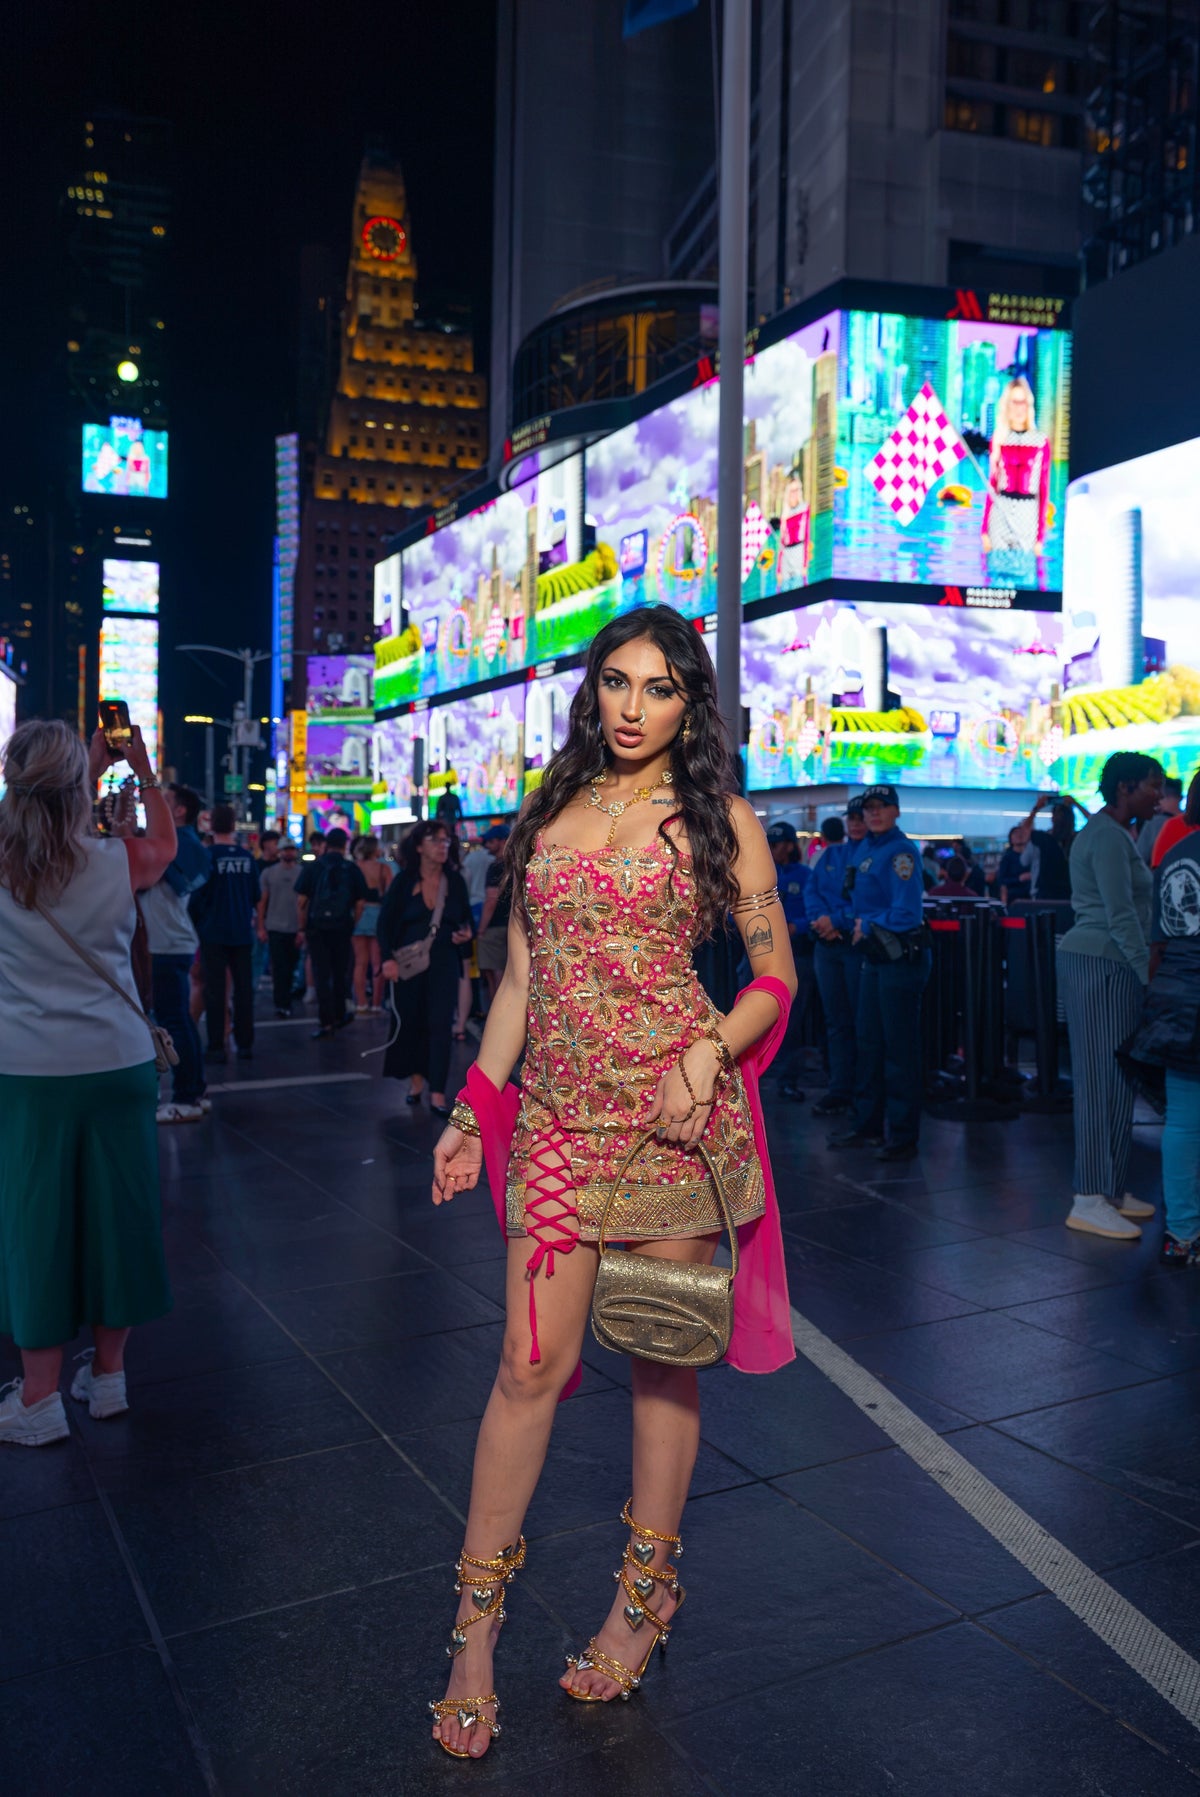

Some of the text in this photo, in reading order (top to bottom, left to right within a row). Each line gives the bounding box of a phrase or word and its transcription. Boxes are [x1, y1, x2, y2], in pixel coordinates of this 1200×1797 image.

[988, 293, 1064, 313] MARRIOTT
[988, 308, 1055, 326] MARQUIS
[217, 860, 251, 874] FATE
